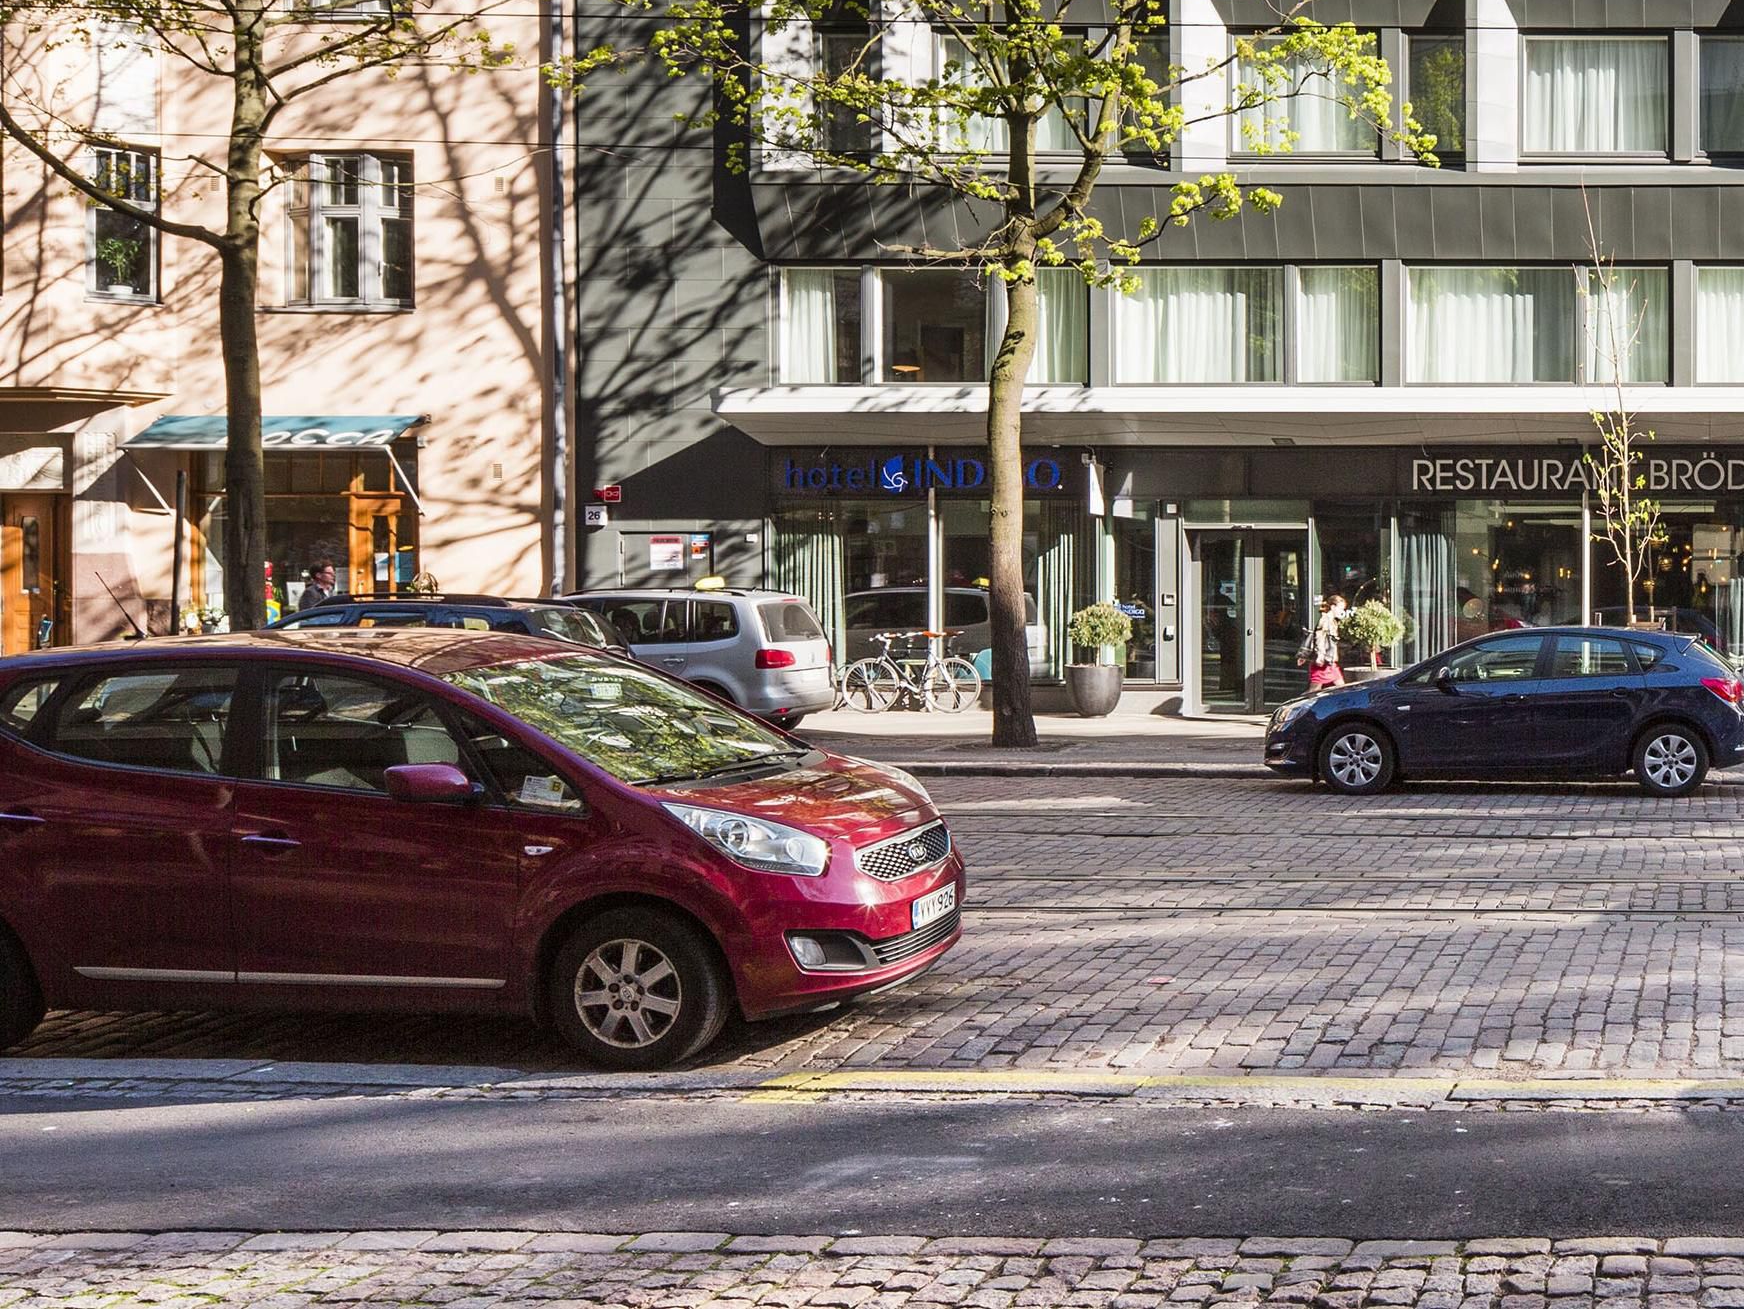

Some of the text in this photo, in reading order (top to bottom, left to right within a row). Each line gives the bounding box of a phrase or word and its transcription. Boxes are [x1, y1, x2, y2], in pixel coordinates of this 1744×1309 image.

[215, 428, 394, 445] OCCA
[784, 457, 1060, 489] hotel INDO
[1412, 459, 1638, 491] RESTAURAN
[588, 511, 601, 521] 26
